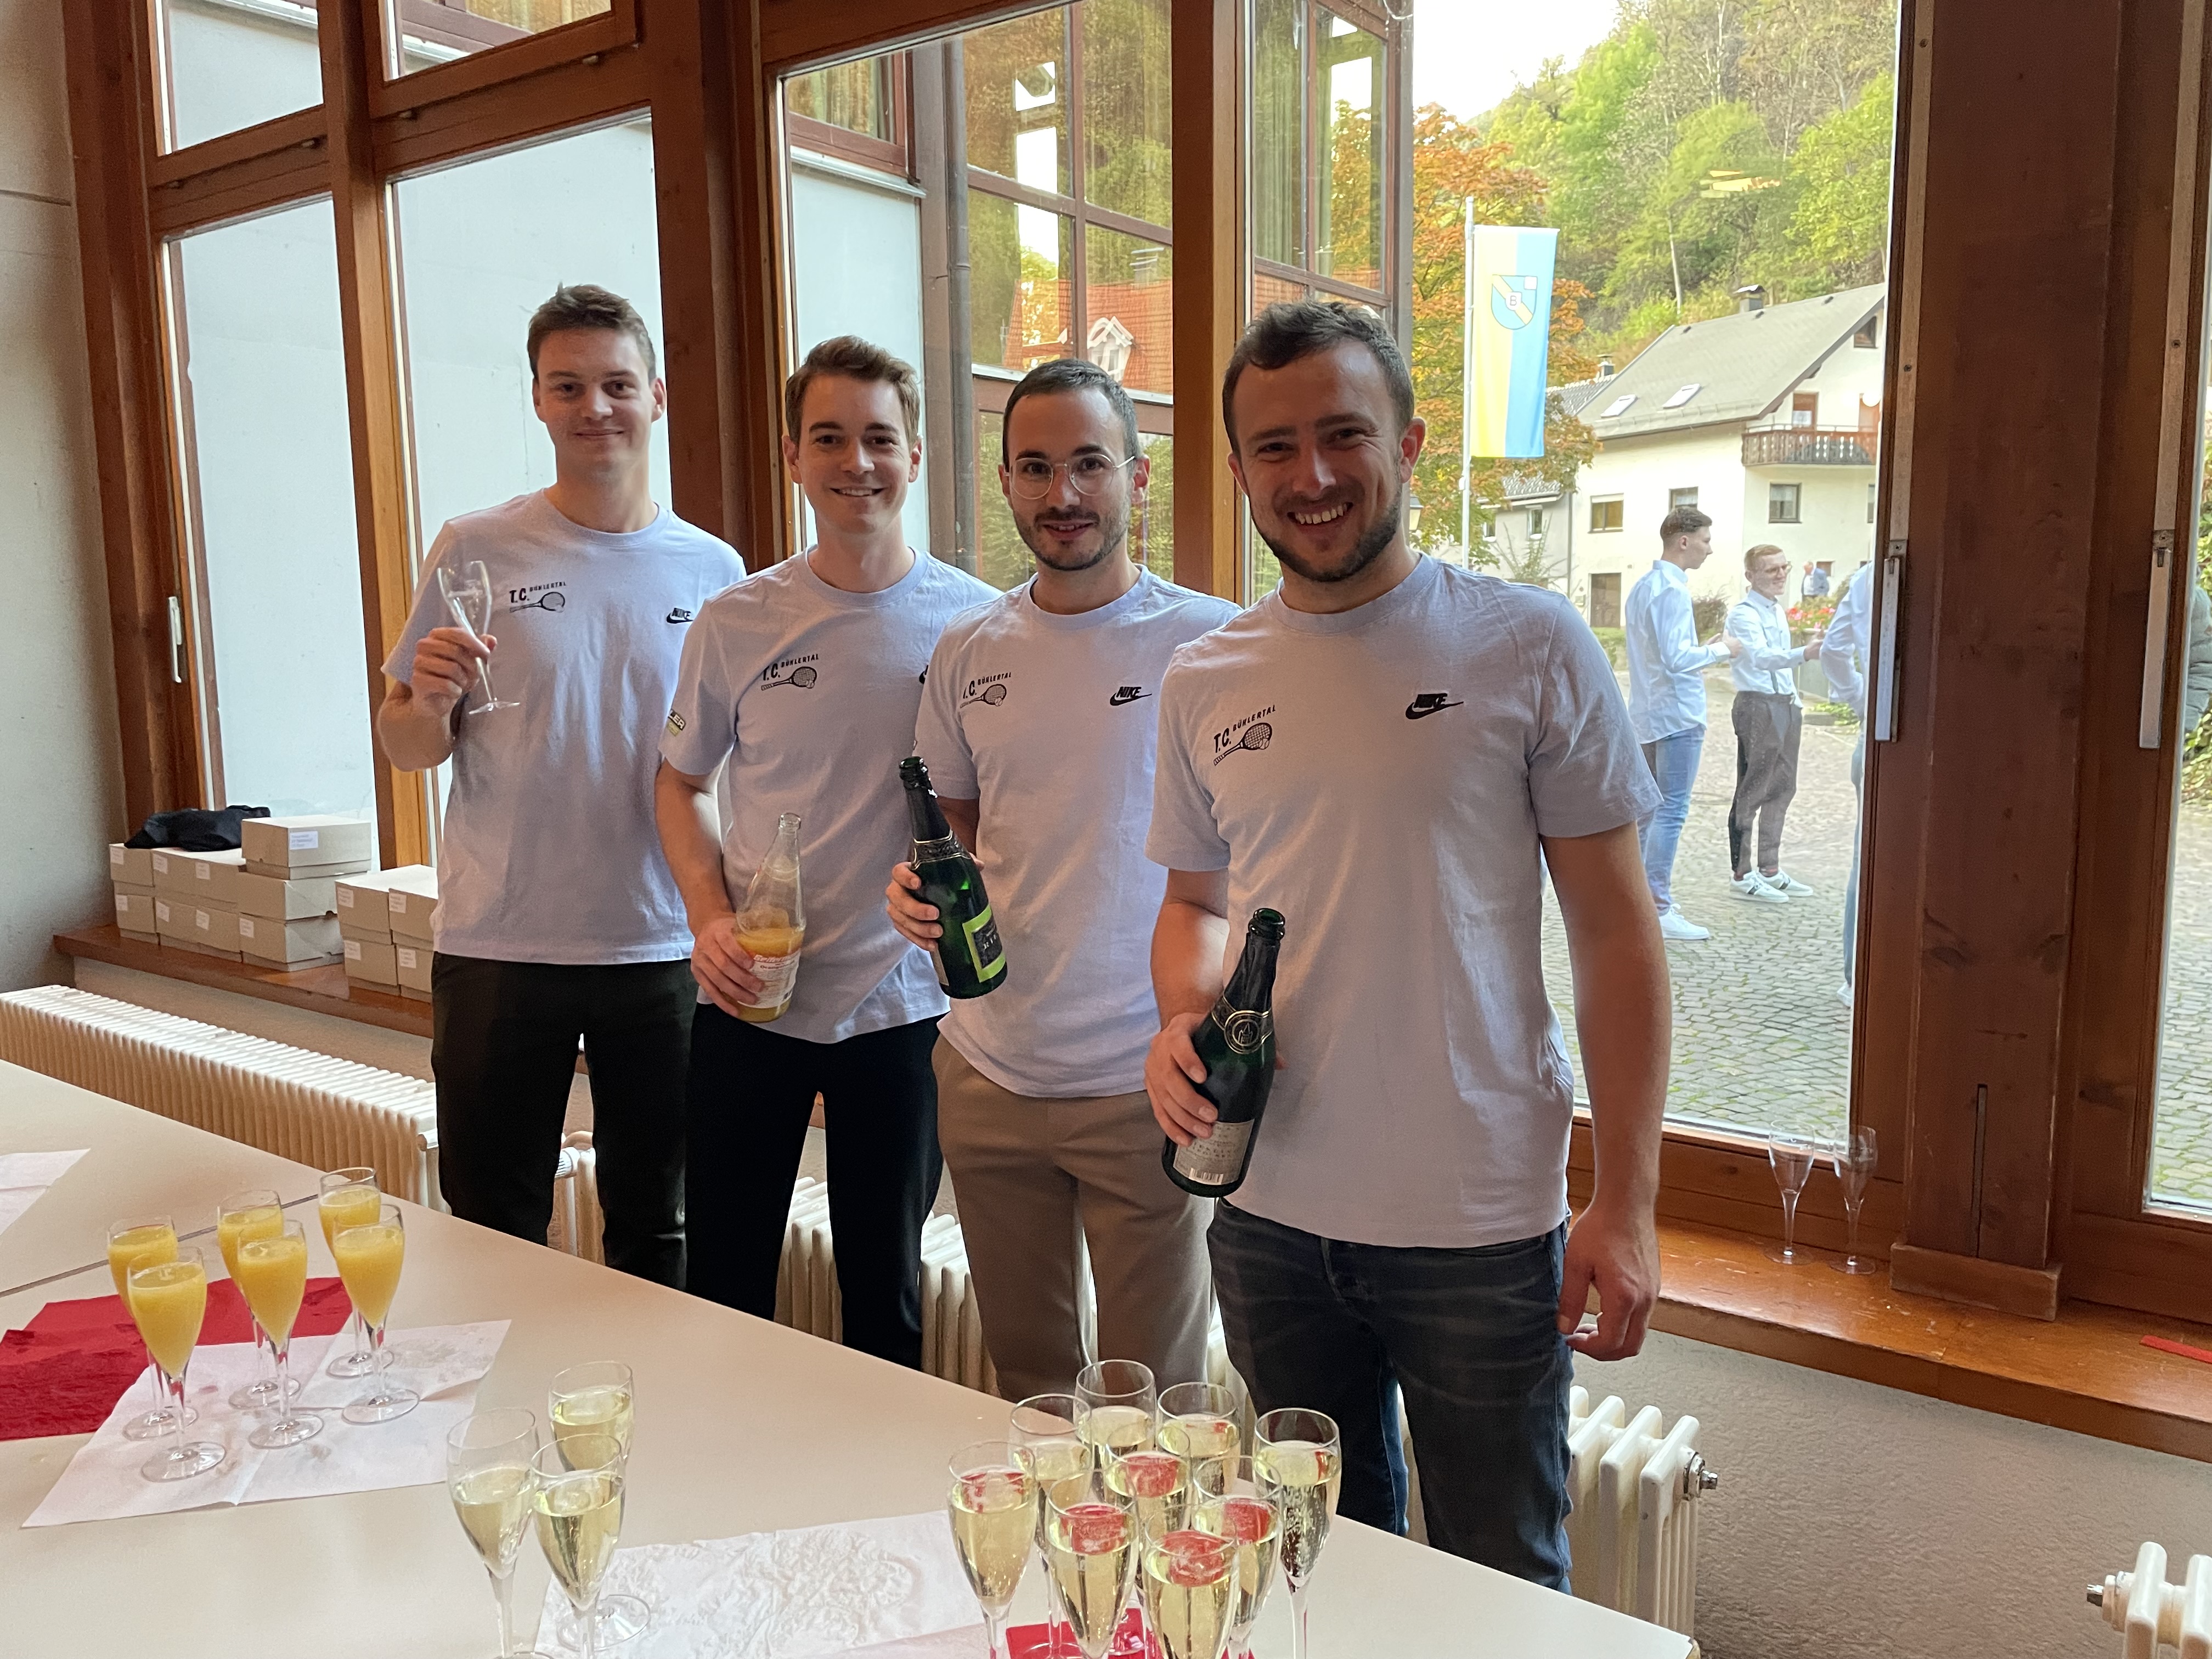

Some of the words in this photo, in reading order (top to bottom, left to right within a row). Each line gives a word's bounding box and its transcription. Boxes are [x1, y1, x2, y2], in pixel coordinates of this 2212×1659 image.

[1510, 295, 1517, 306] B
[1116, 686, 1142, 698] NIKE
[1214, 727, 1231, 753] T.C.
[1233, 704, 1276, 731] BÜHLERTAL
